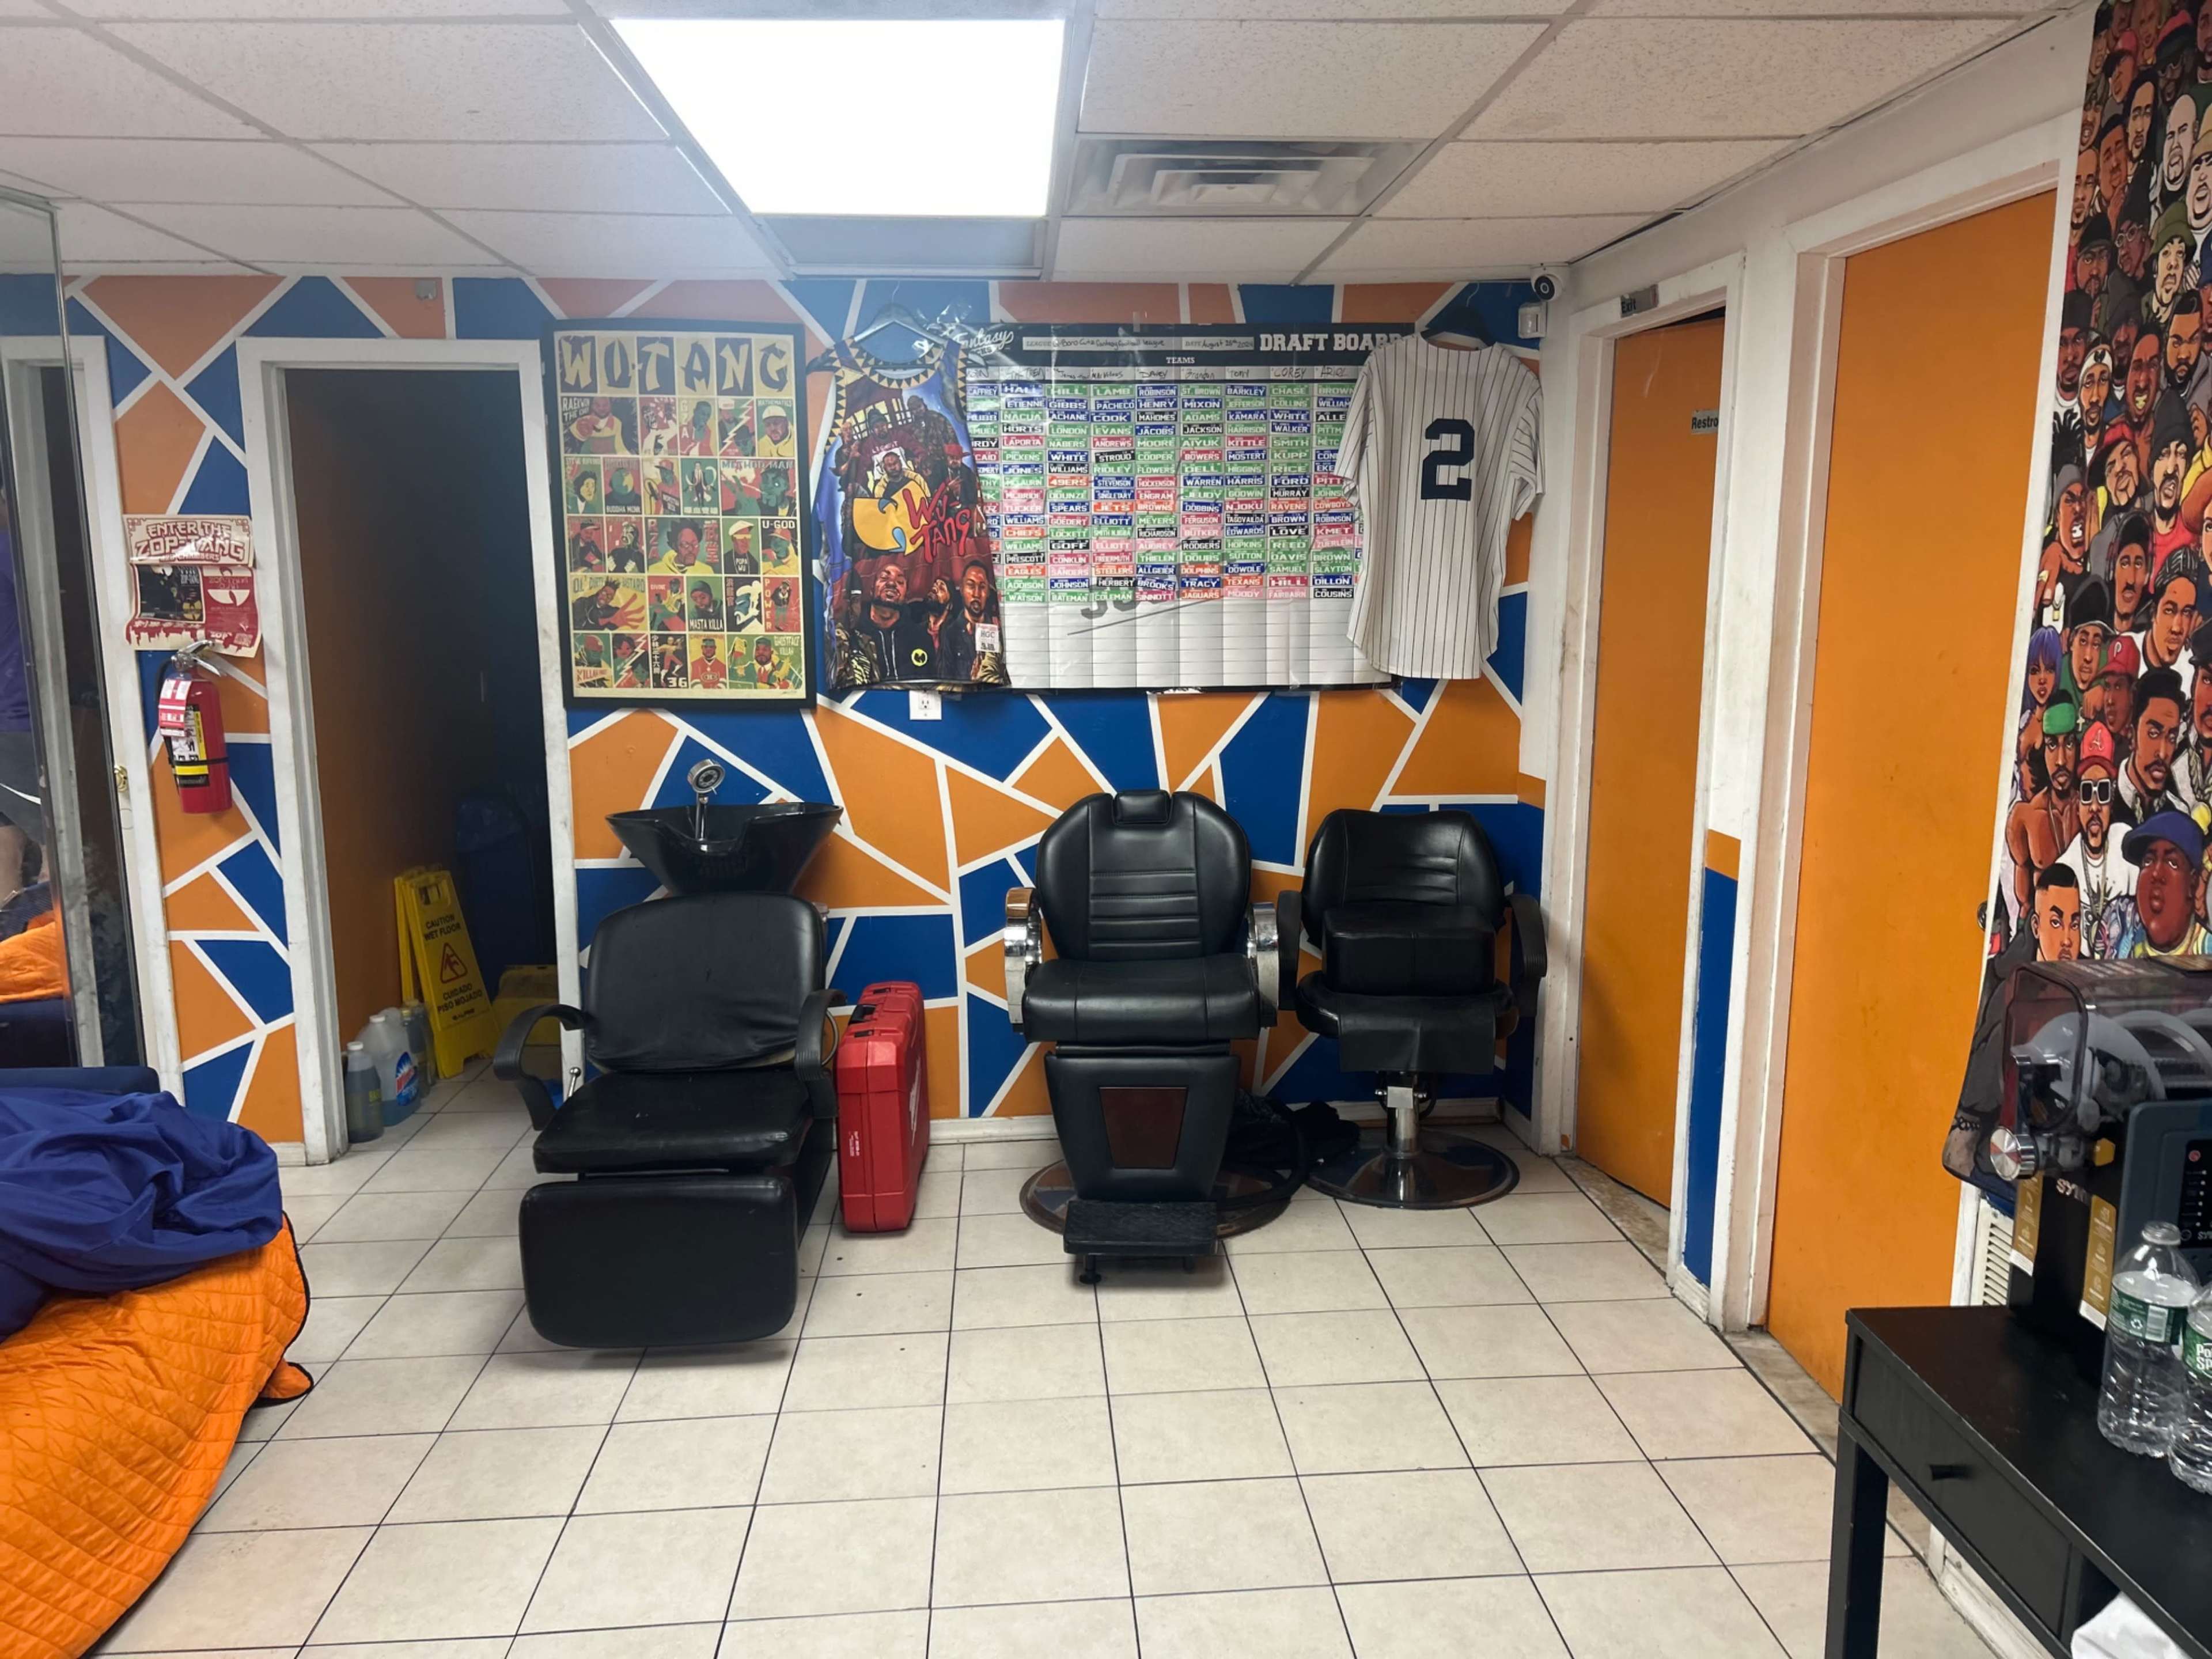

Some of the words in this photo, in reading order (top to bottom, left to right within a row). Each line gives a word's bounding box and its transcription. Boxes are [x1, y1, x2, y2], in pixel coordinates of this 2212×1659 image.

[1621, 298, 1637, 314] Exit
[1260, 334, 1328, 351] DRAFT
[1691, 415, 1718, 430] Restro
[1099, 453, 1131, 462] STROUD
[1421, 418, 1475, 501] 2
[1315, 501, 1351, 510] COWBOYS
[147, 521, 198, 537] ENTER
[202, 521, 231, 537] THE
[762, 520, 795, 529] U-GOD
[1226, 527, 1264, 535] EDWARDS
[1137, 579, 1173, 591] BROOKS
[764, 578, 772, 630] POWER
[689, 619, 707, 630] MASTA
[709, 619, 724, 630] KILLA
[774, 636, 800, 646] GHOSTFACE
[2113, 641, 2122, 658] P
[667, 677, 687, 687] 36
[2089, 729, 2105, 751] A
[426, 914, 455, 929] CAUTION
[424, 929, 438, 941] WET
[440, 922, 461, 937] FLOOR
[442, 983, 472, 1001] CUIDADO
[437, 1000, 454, 1014] PISO
[455, 990, 483, 1006] MOJADO
